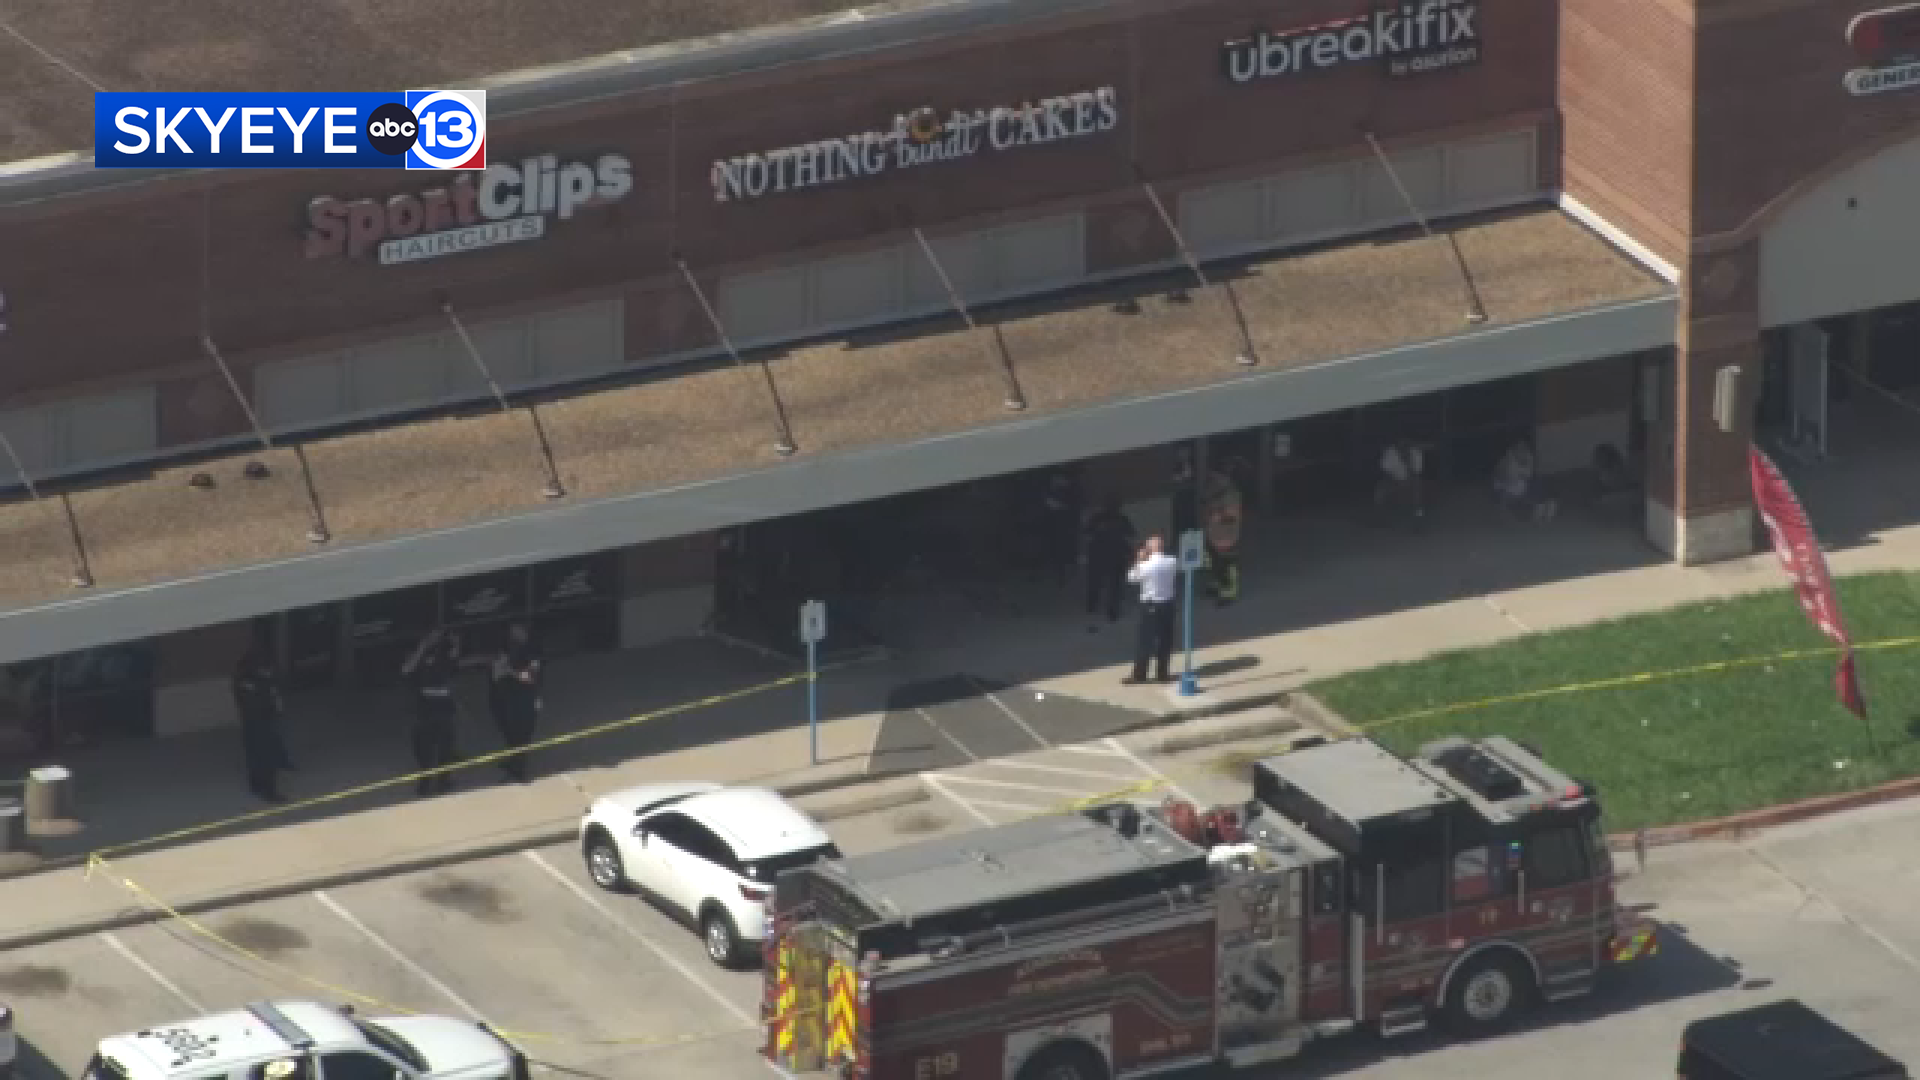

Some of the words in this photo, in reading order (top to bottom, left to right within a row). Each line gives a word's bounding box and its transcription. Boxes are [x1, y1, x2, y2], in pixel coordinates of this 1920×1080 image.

[1229, 0, 1476, 82] ubreakifix
[711, 130, 886, 201] NOTHING
[991, 85, 1117, 149] CAKES
[385, 219, 538, 261] HAIRCUTS
